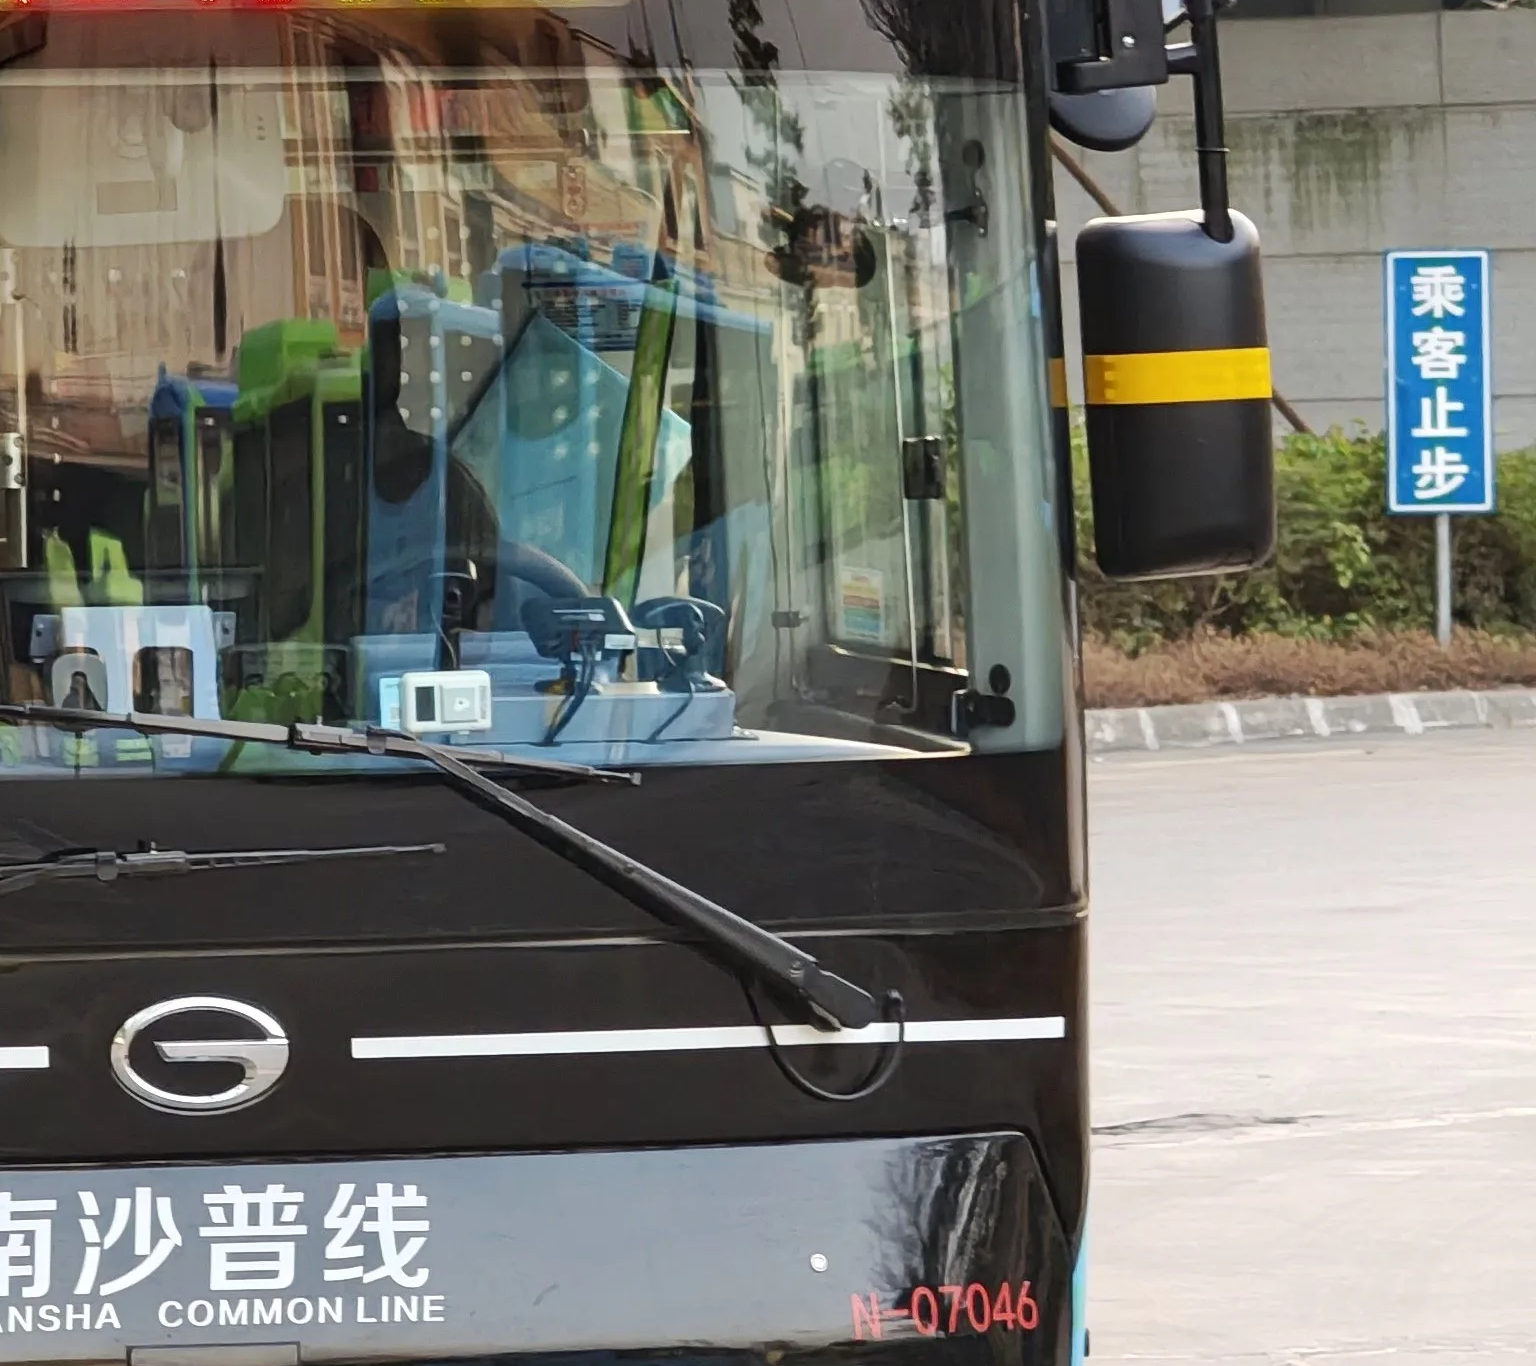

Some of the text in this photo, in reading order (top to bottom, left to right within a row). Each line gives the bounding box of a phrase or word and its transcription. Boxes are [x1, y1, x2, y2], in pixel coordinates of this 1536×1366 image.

[1410, 265, 1470, 501] 乘客止步
[158, 1296, 344, 1328] COMMON
[356, 1294, 446, 1323] LINE
